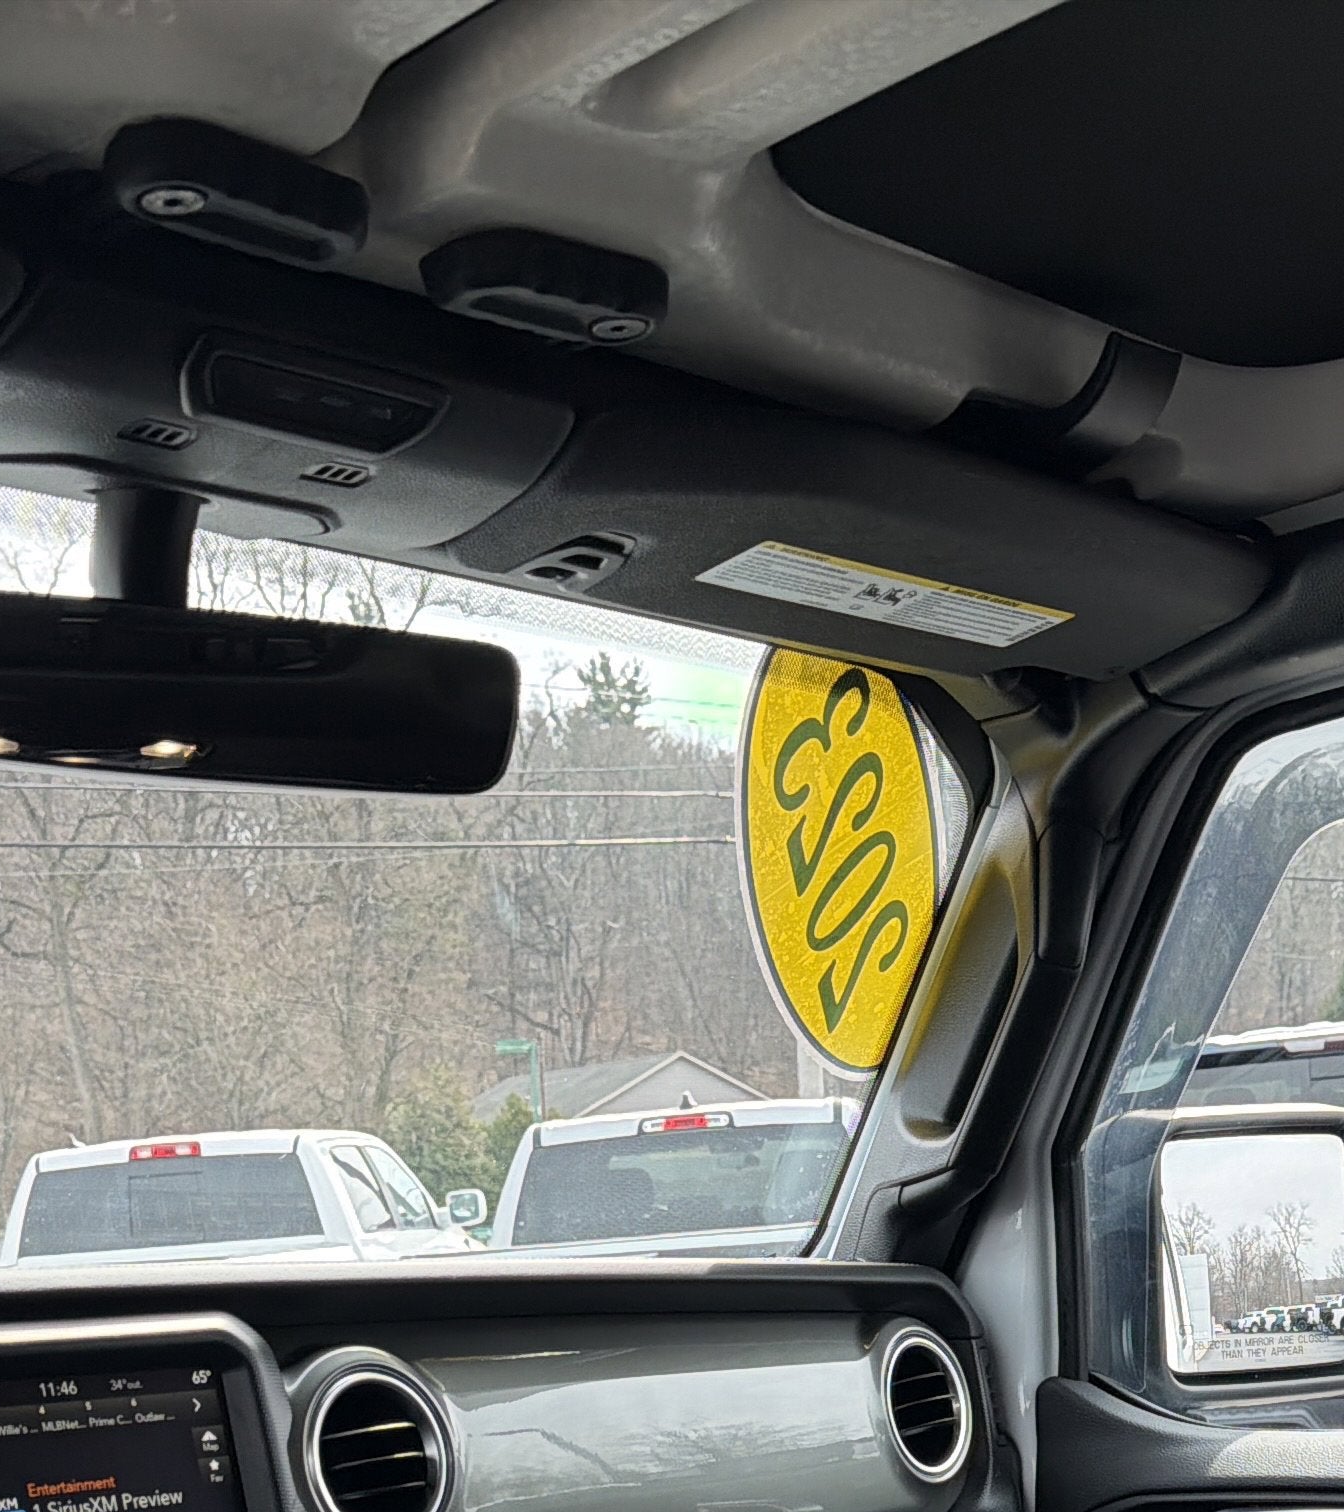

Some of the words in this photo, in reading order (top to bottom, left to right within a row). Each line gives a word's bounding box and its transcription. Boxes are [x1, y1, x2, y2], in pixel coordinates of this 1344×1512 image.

[1193, 1338, 1230, 1350] OBJECTS
[1234, 1339, 1242, 1347] IN
[1245, 1337, 1274, 1347] MIRROR
[1278, 1336, 1294, 1345] ARE
[1298, 1333, 1329, 1344] CLOSER
[1221, 1350, 1243, 1360] THAN
[1247, 1348, 1266, 1358] THEY
[1271, 1345, 1304, 1356] APPEAR
[39, 1381, 78, 1398] 11:46
[26, 1476, 117, 1498] Entertainment
[121, 1489, 183, 1510] Preview
